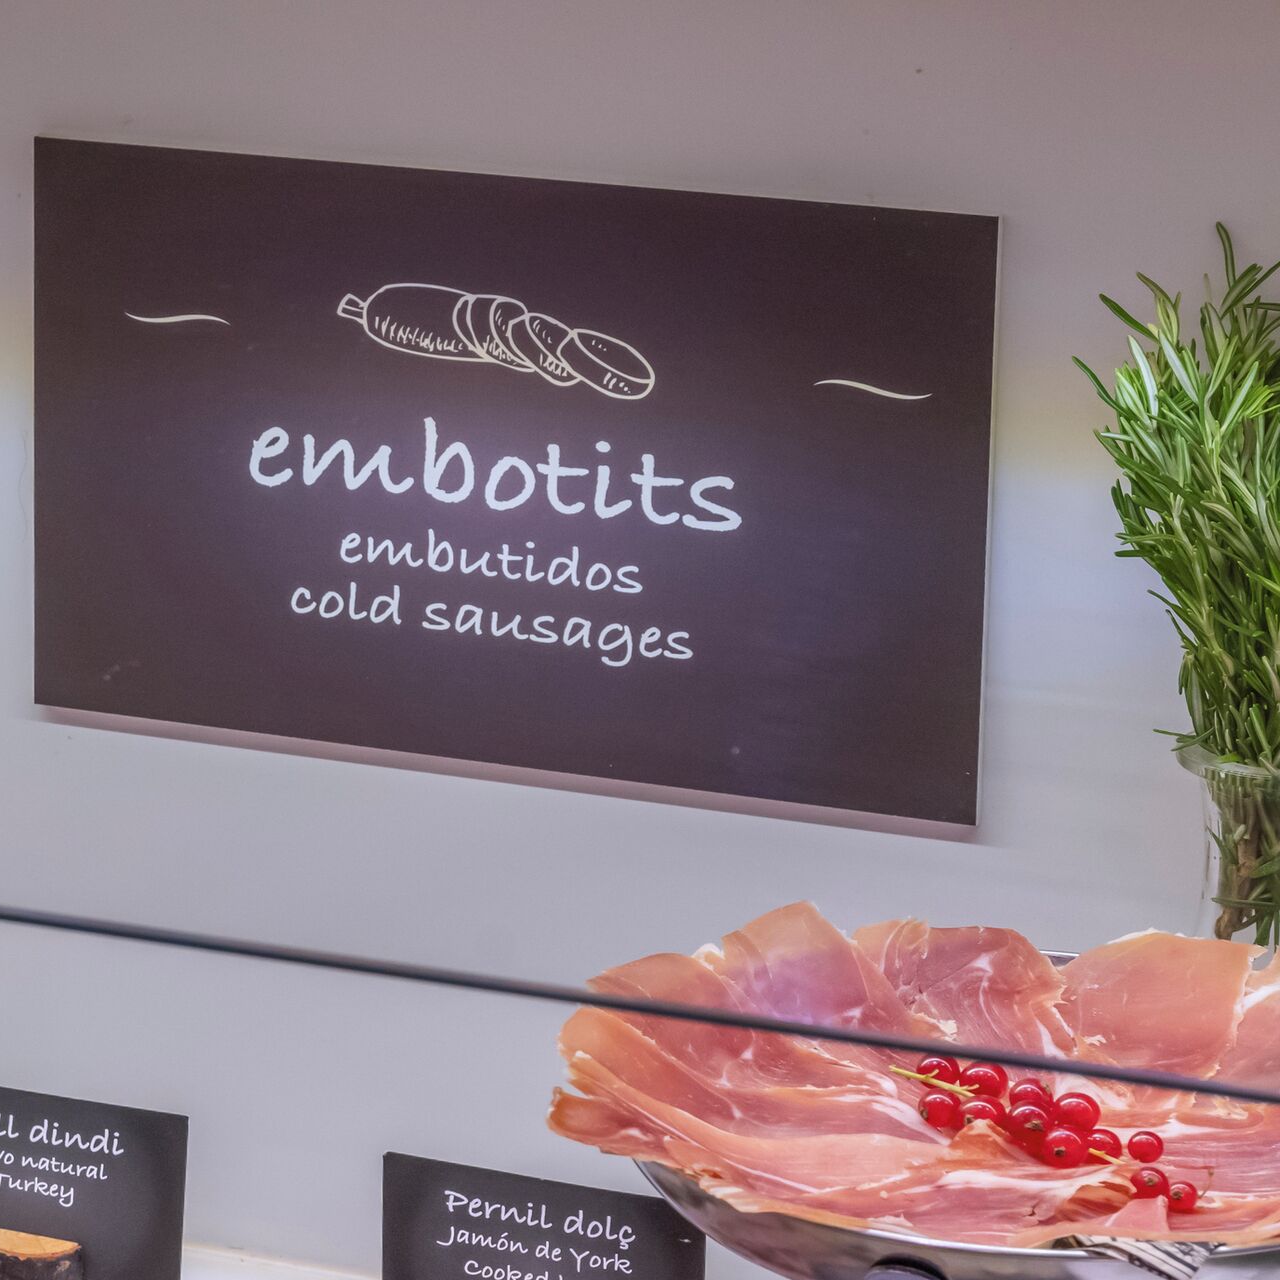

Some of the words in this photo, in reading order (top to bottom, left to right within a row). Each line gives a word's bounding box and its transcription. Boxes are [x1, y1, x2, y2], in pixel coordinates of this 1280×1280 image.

[249, 416, 743, 532] embotits
[340, 528, 643, 594] embutidos
[290, 581, 402, 625] cold
[421, 602, 694, 667] sausages
[21, 1155, 108, 1180] natural
[28, 1118, 125, 1156] dindi
[436, 1225, 529, 1254] Jamón
[534, 1240, 562, 1262] de
[569, 1247, 633, 1275] York
[444, 1189, 553, 1229] Pernil
[563, 1209, 636, 1251] dolç
